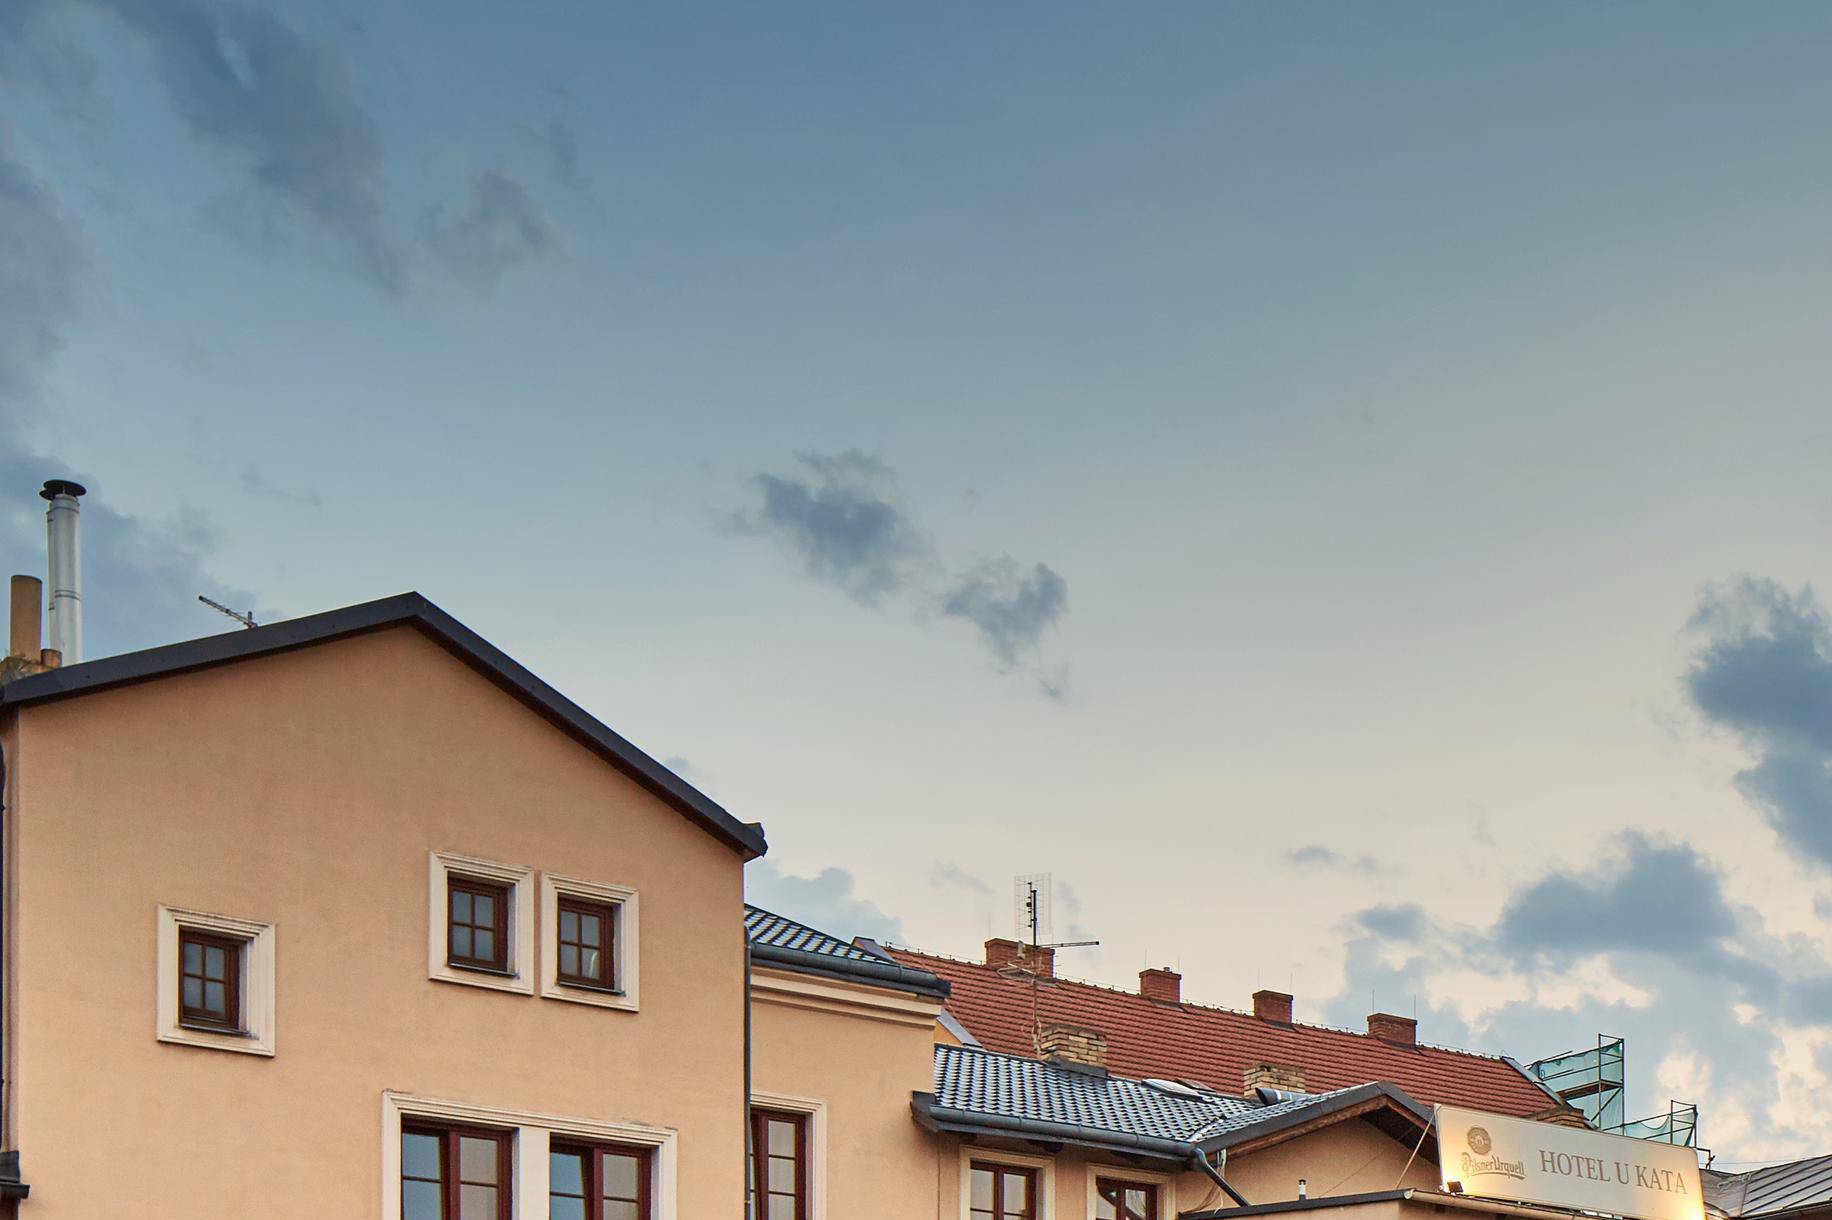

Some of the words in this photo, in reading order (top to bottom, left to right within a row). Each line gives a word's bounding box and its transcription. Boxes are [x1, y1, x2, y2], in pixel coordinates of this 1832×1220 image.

[1539, 1150, 1611, 1182] HOTEL
[1614, 1162, 1629, 1185] U
[1635, 1165, 1688, 1195] KATA
